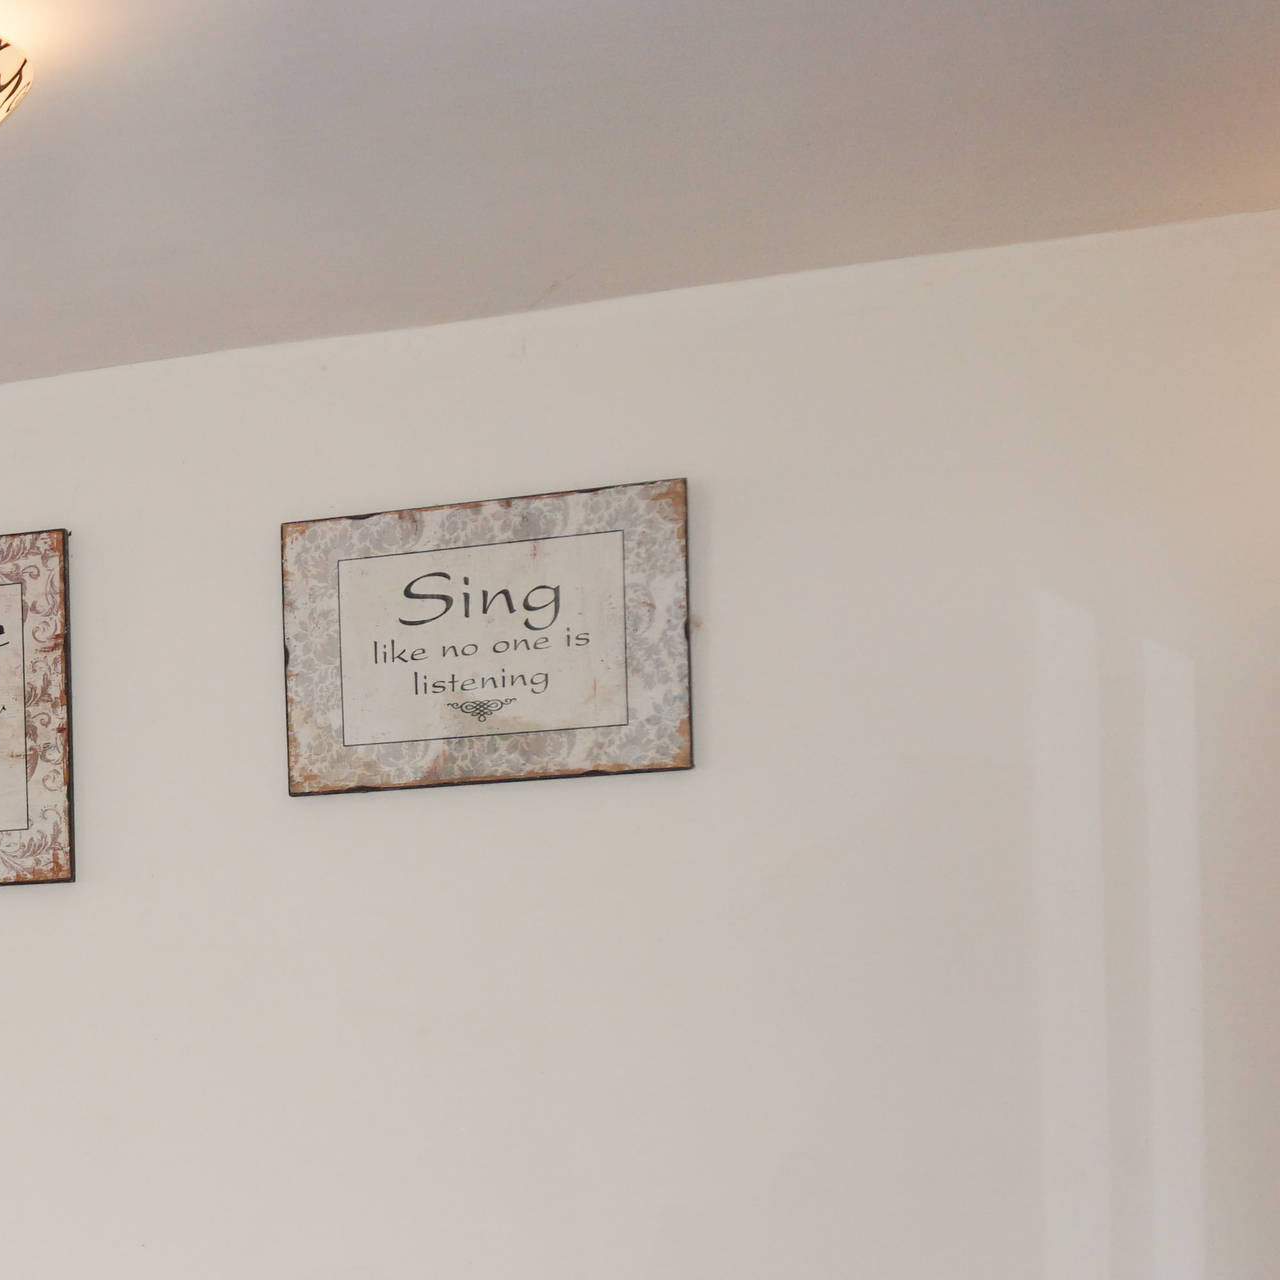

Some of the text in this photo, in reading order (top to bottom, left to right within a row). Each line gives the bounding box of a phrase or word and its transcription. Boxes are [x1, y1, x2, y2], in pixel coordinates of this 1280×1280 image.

[398, 571, 561, 632] Sing
[373, 627, 591, 665] like no one is
[413, 667, 549, 696] listening
